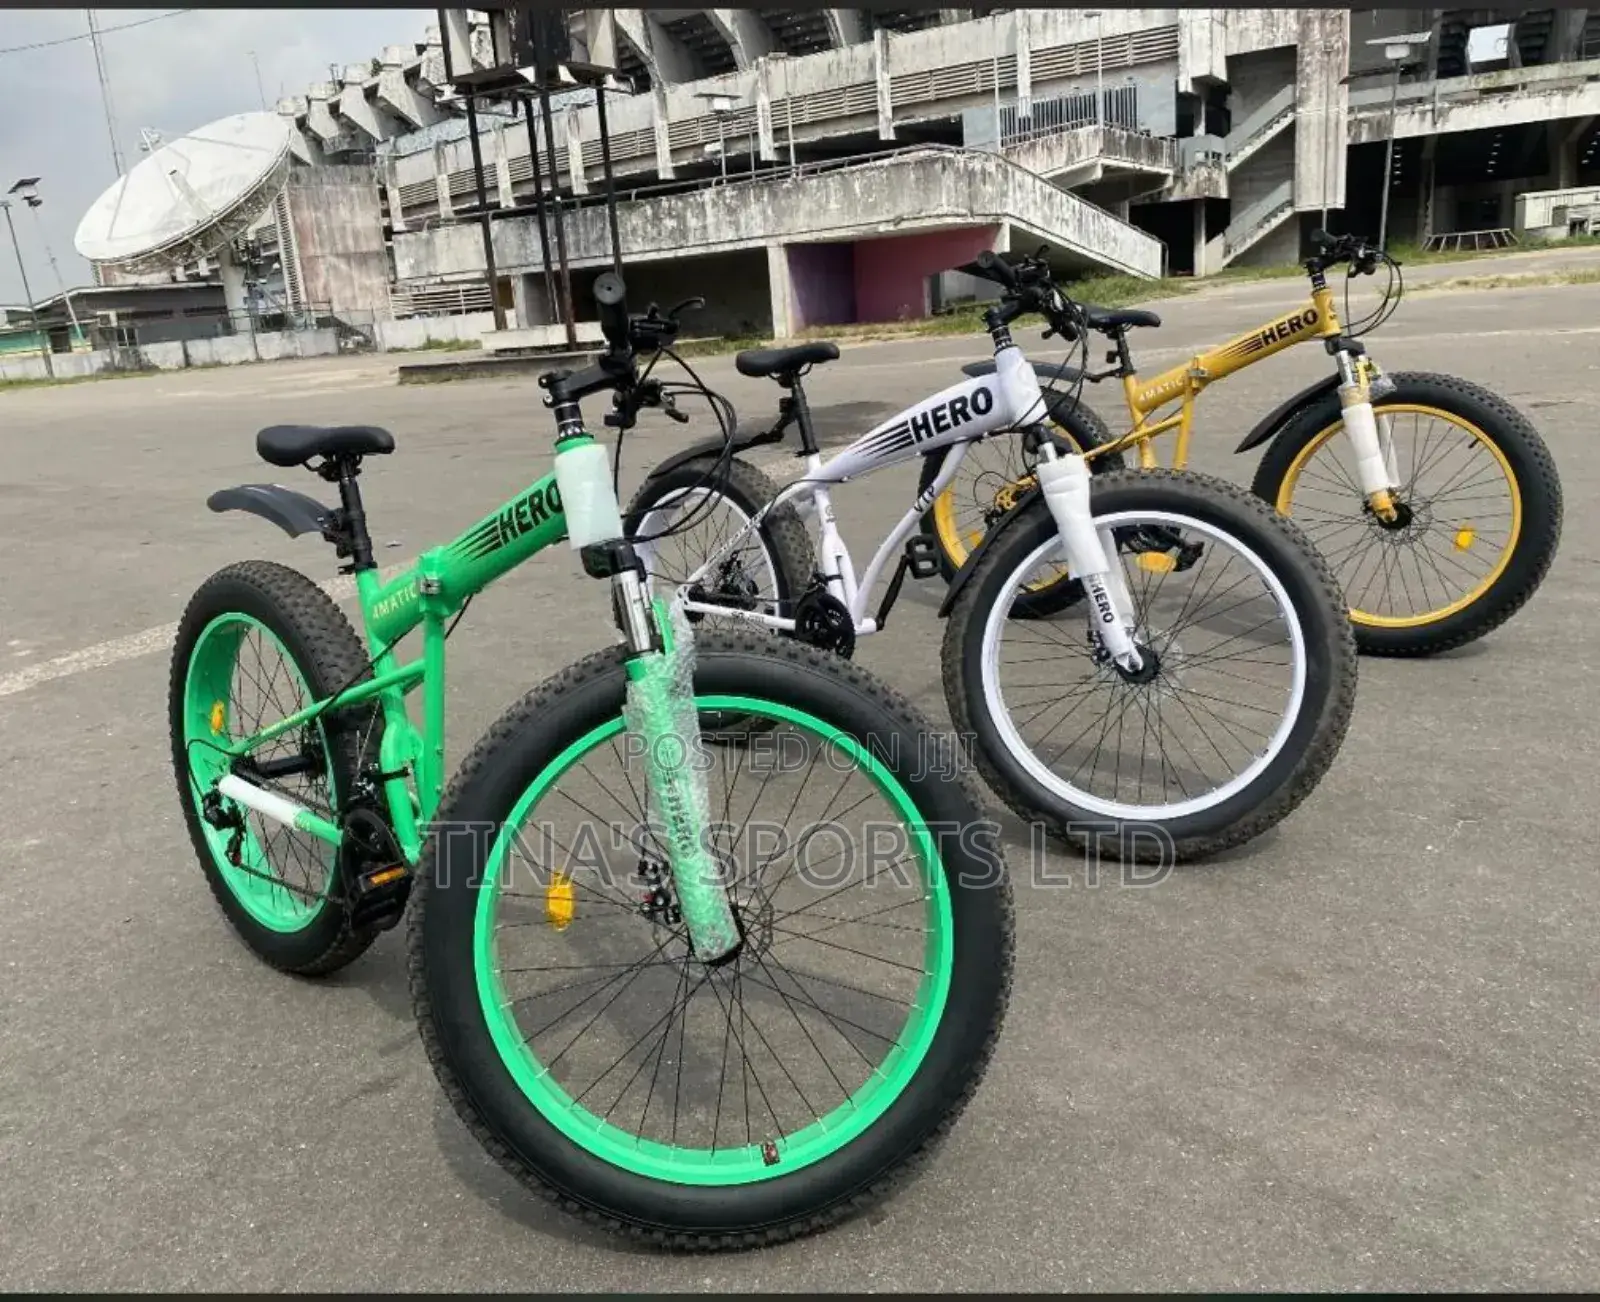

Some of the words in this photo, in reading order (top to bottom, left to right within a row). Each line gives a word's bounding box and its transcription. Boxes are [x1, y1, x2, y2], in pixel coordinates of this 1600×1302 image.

[1261, 309, 1318, 345] HERO
[911, 386, 993, 443] HERO
[500, 479, 564, 546] HERO
[1090, 583, 1115, 624] HERO
